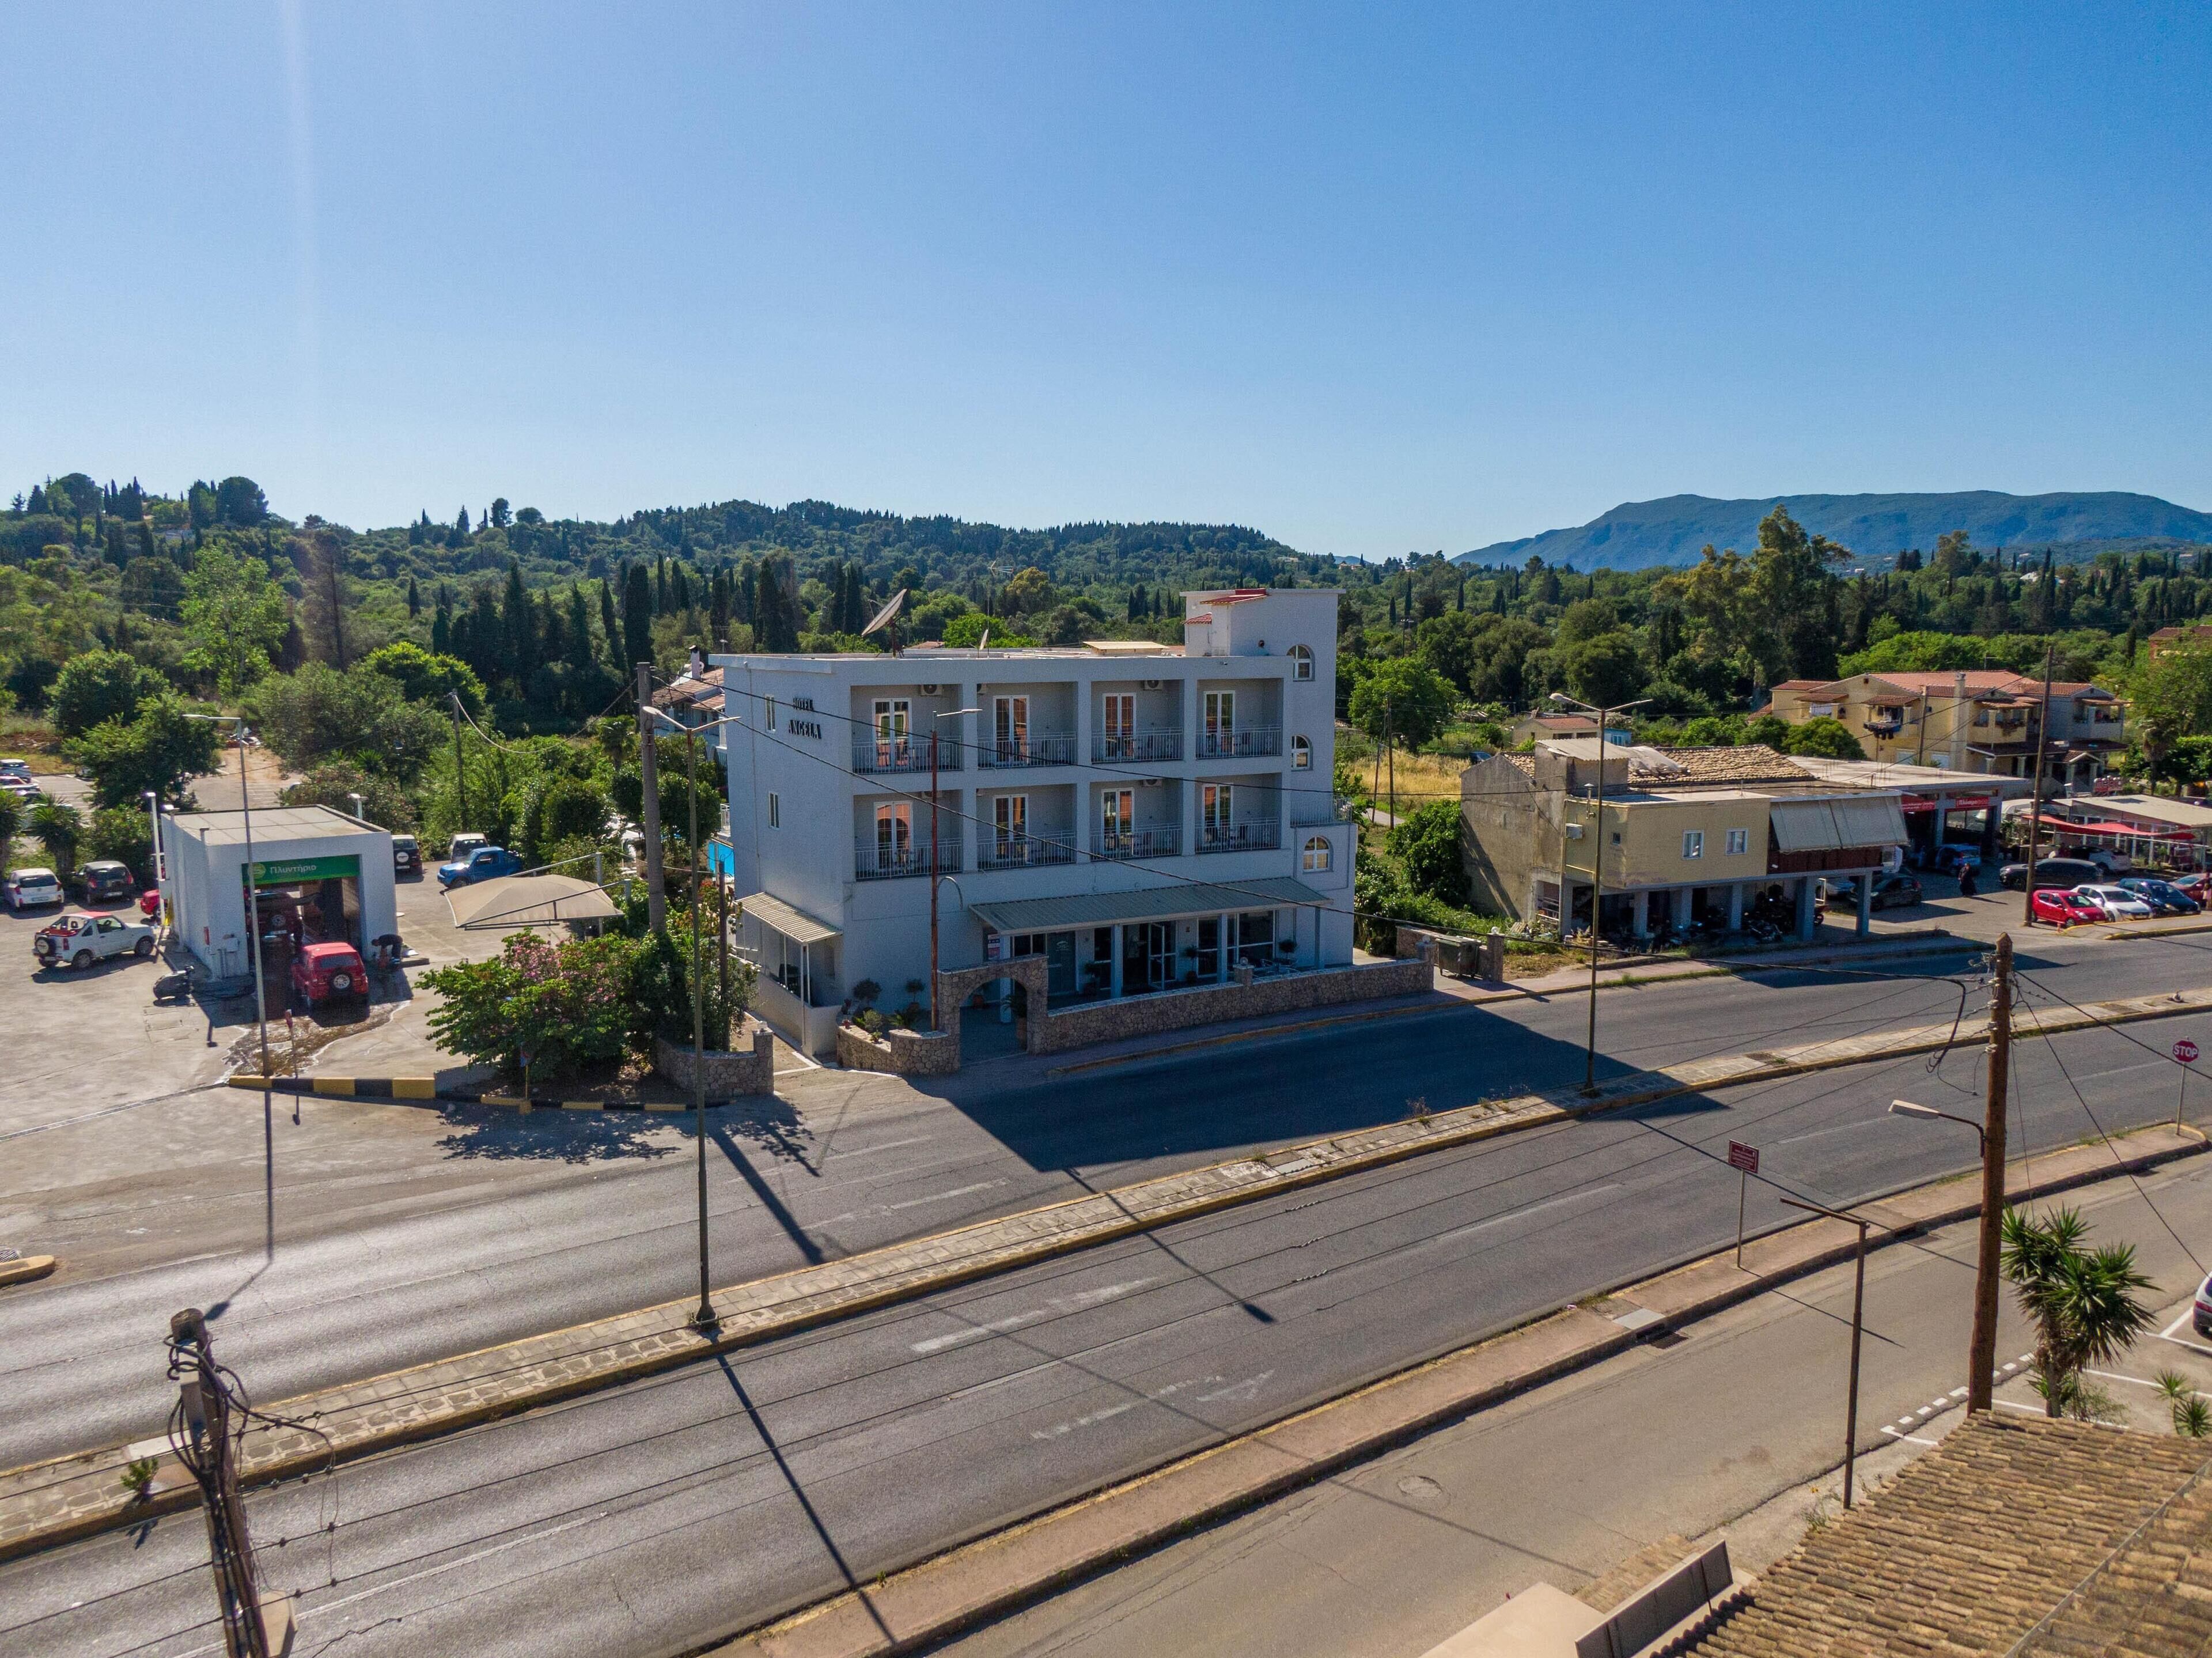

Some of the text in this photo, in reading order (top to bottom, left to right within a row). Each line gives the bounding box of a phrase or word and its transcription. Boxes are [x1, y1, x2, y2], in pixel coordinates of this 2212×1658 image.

[793, 698, 812, 710] HOTEL
[789, 720, 820, 739] ANGELA
[270, 865, 316, 874] Πλυντήριο
[2173, 1044, 2198, 1058] STOP
